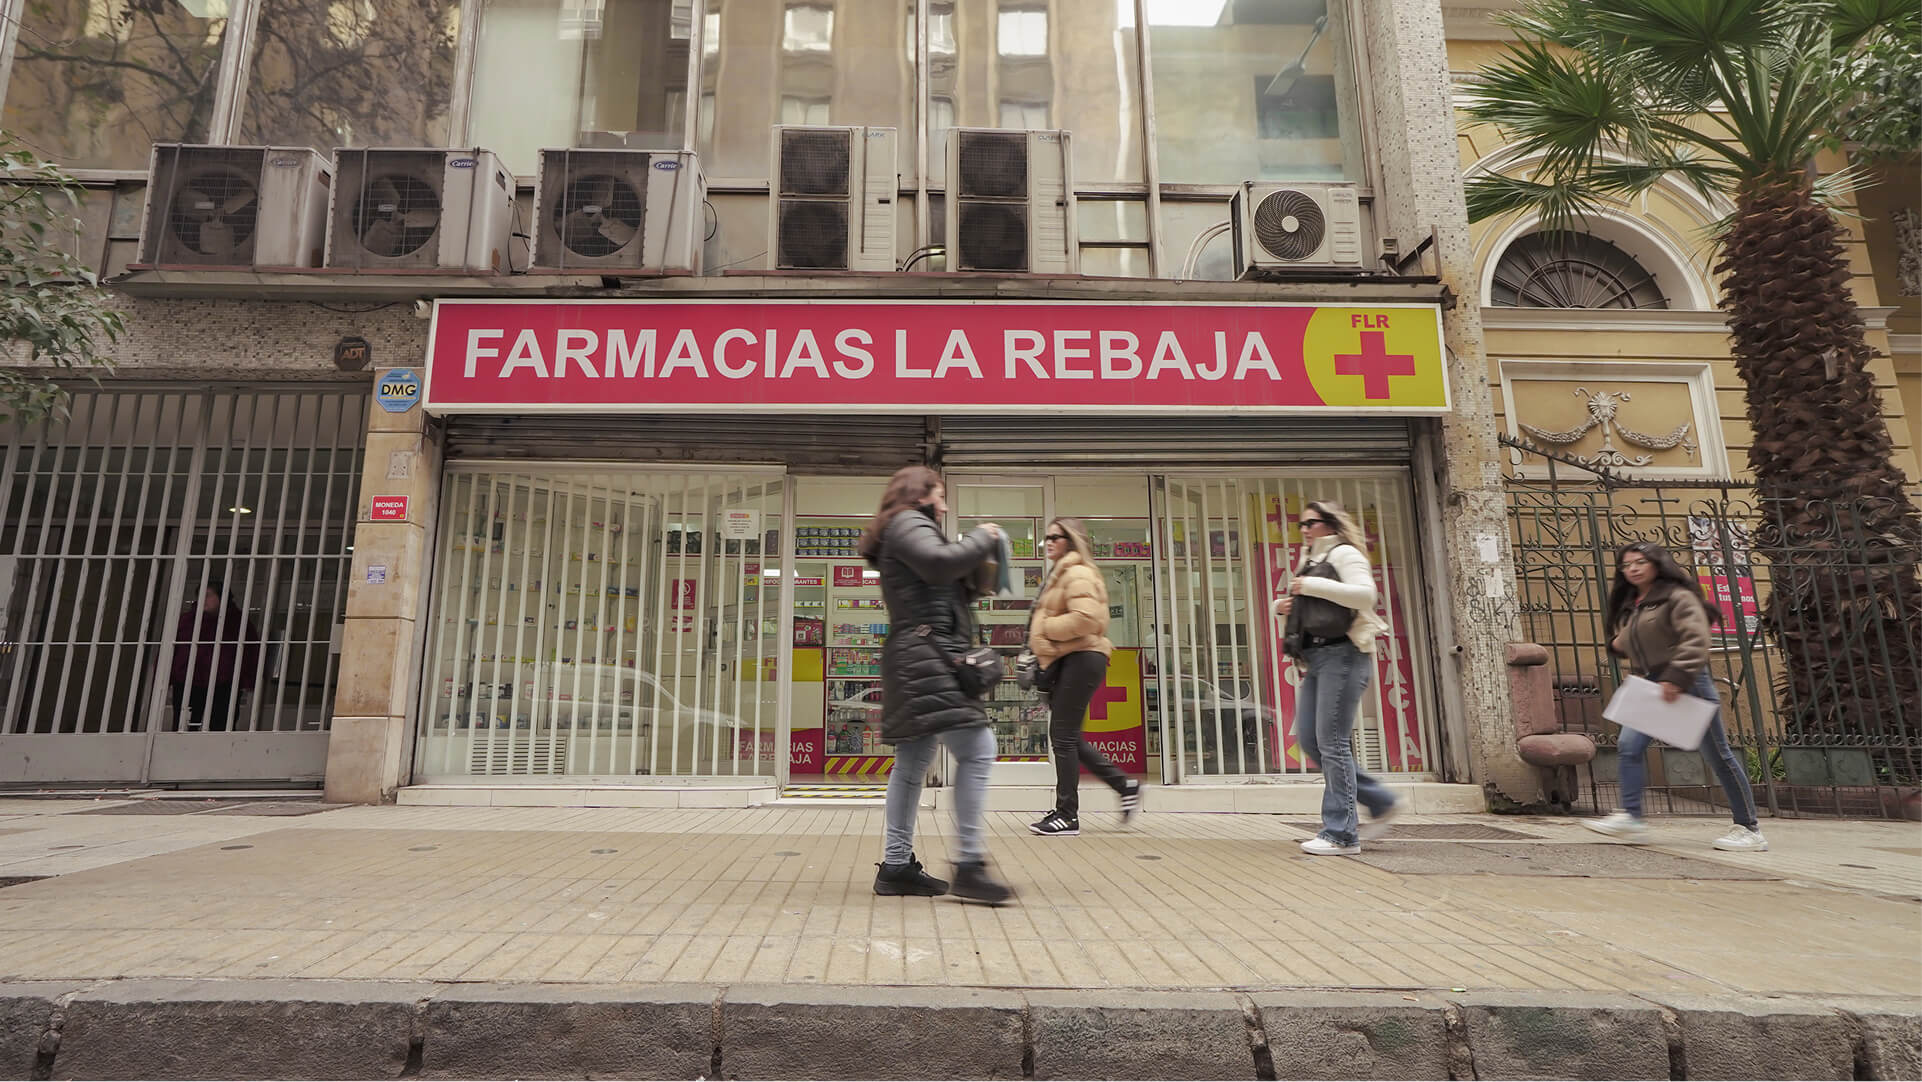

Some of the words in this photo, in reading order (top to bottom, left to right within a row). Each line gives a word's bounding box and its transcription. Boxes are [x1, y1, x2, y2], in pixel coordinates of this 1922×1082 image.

[1351, 314, 1389, 328] FLR
[342, 347, 365, 359] ADT
[463, 328, 875, 379] FARMACIAS
[895, 329, 984, 379] LA
[1004, 329, 1282, 381] REBAJA
[381, 384, 417, 396] DMG
[1088, 741, 1137, 752] MACIAS
